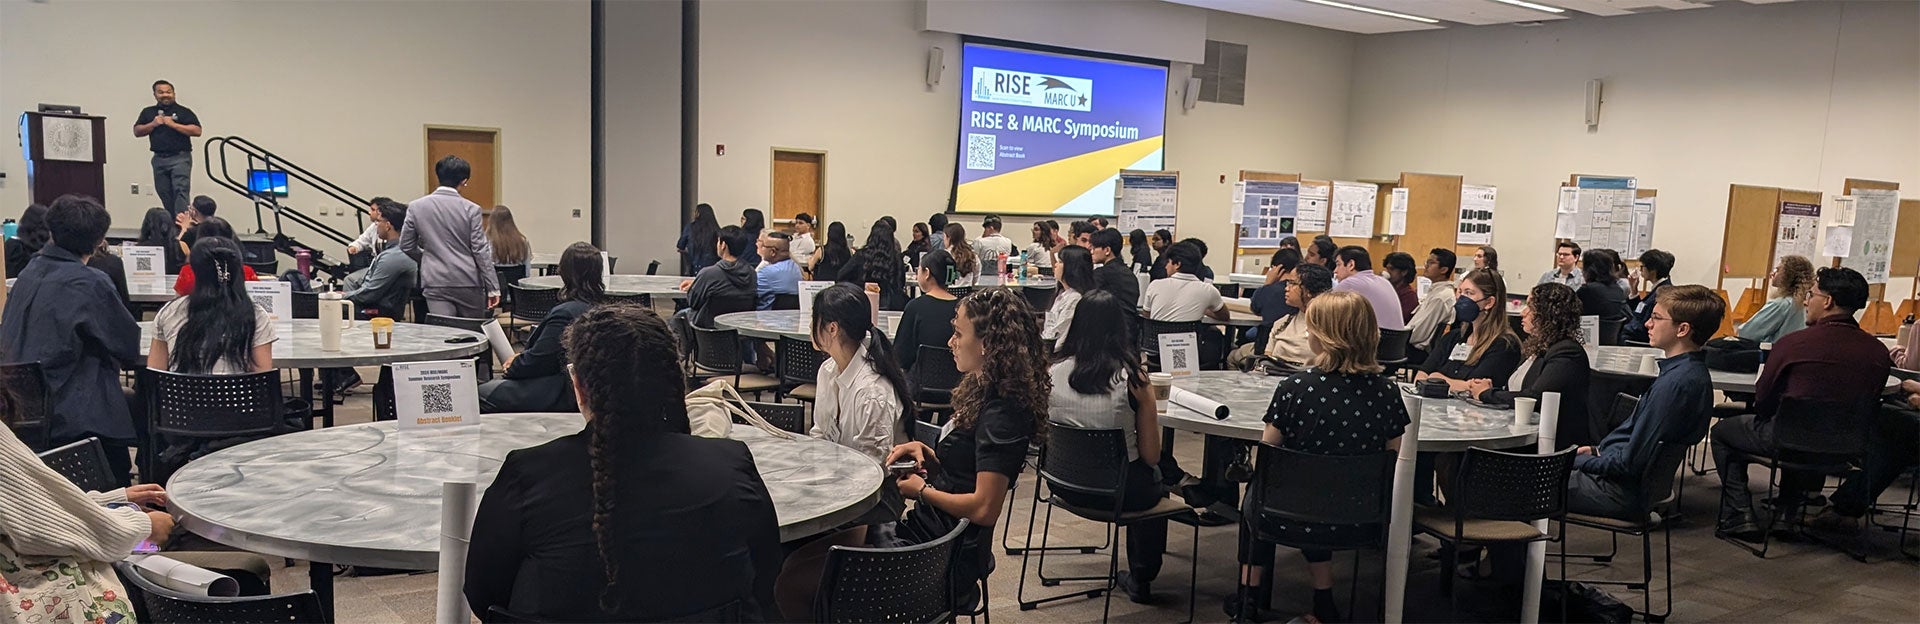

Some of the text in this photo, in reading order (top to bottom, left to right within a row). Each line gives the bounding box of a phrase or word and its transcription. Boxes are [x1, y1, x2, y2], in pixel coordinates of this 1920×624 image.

[995, 72, 1031, 95] RISE
[1044, 92, 1068, 107] MARC
[1070, 94, 1076, 107] U
[971, 110, 1139, 140] RISE & MARC Symposium
[441, 415, 462, 423] Booklet
